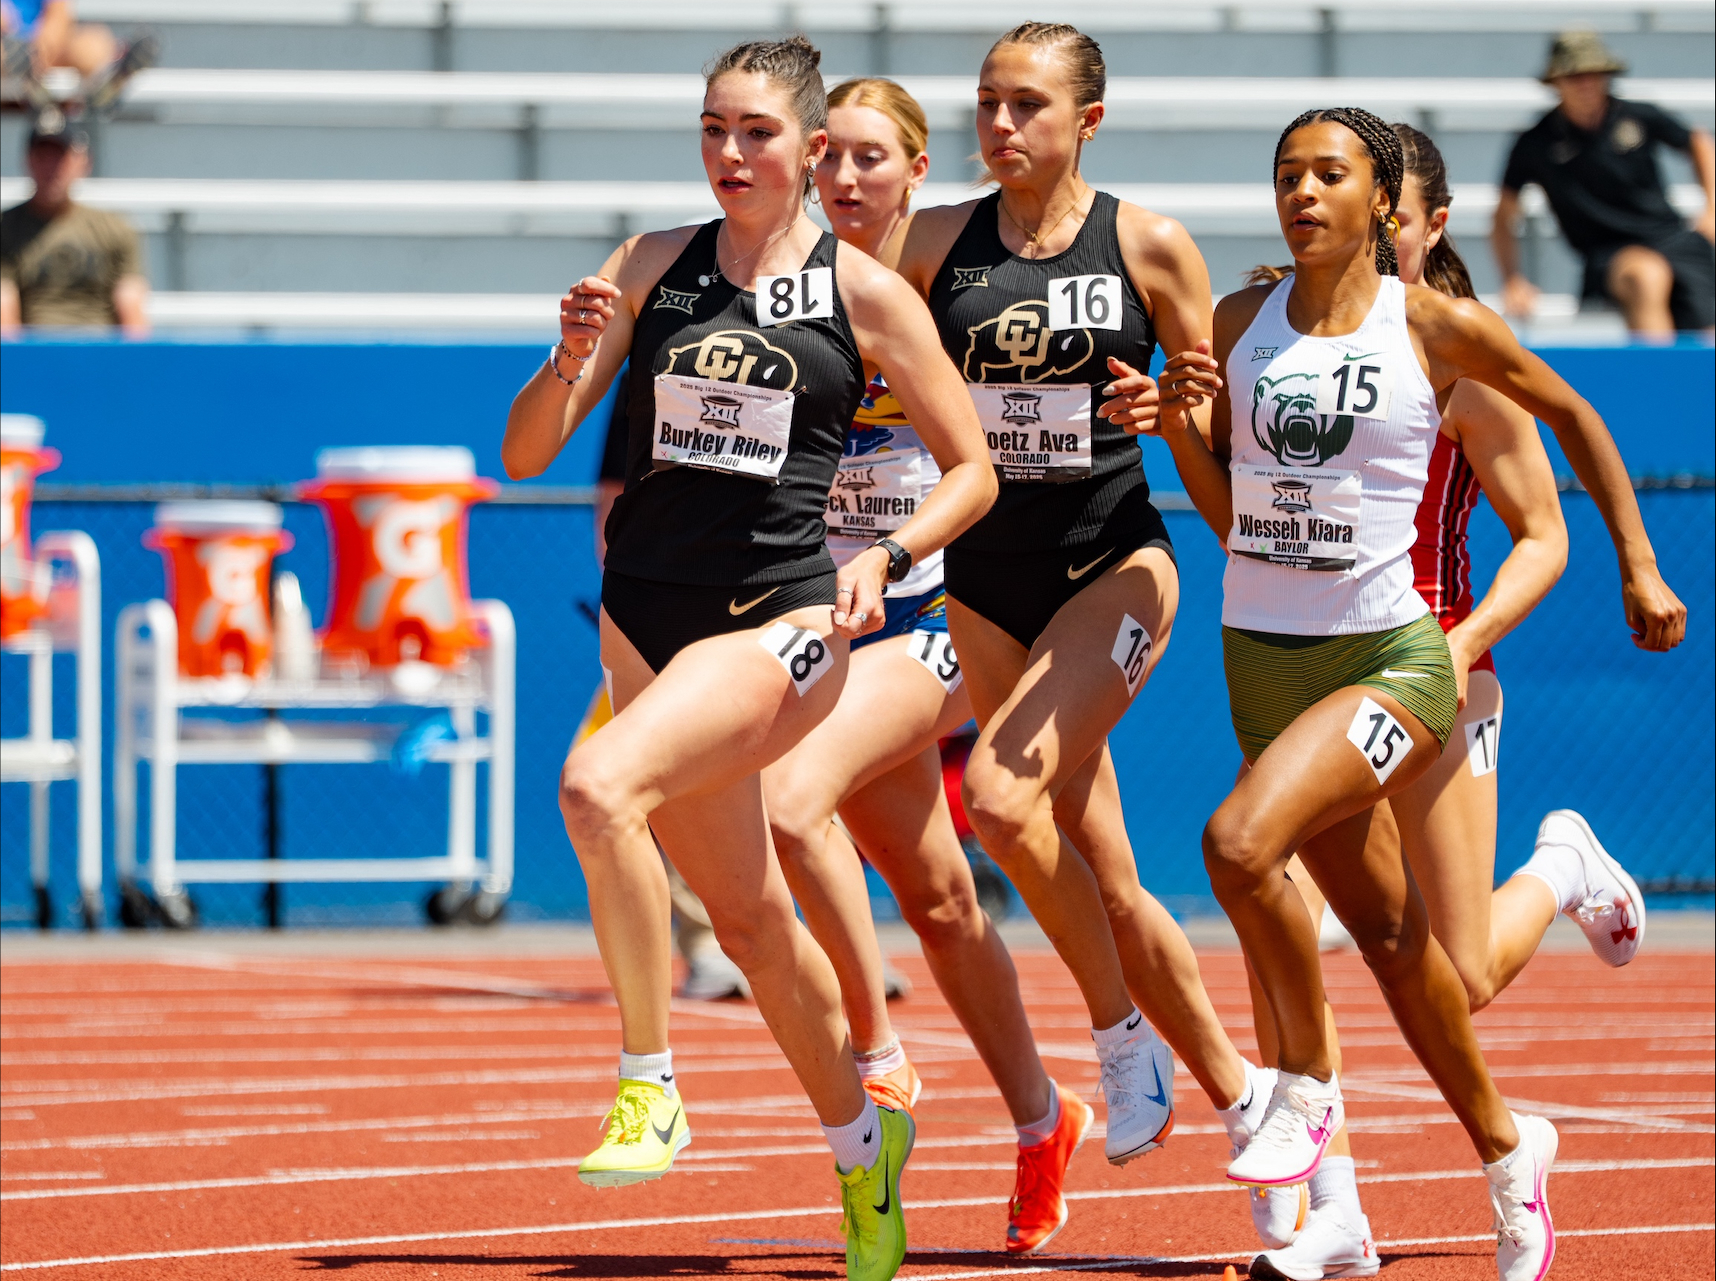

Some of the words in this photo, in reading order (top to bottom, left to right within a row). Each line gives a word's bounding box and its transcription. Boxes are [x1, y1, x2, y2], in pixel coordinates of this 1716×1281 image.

[769, 272, 819, 319] 18
[1061, 277, 1110, 325] 16
[712, 387, 732, 395] Outdoor
[733, 390, 772, 401] Championships
[1332, 364, 1381, 414] 15
[659, 421, 726, 455] Burkey
[731, 434, 782, 463] Riley
[984, 430, 1029, 452] oetz
[1039, 430, 1078, 452] Ava
[1000, 452, 1050, 465] COLORADO
[688, 452, 740, 467] COLORADO
[1003, 466, 1023, 474] University
[1302, 473, 1341, 481] Championships
[843, 514, 876, 528] KANSAS
[855, 494, 914, 516] Lauren
[374, 498, 443, 579] G
[1238, 513, 1300, 541] Wesseh
[1308, 518, 1353, 543] Kiara
[1274, 541, 1309, 554] BAYLOR
[777, 626, 825, 682] 18
[919, 633, 960, 683] 19
[1123, 627, 1151, 685] 16
[1363, 712, 1406, 770] 15
[1474, 717, 1498, 770] 17
